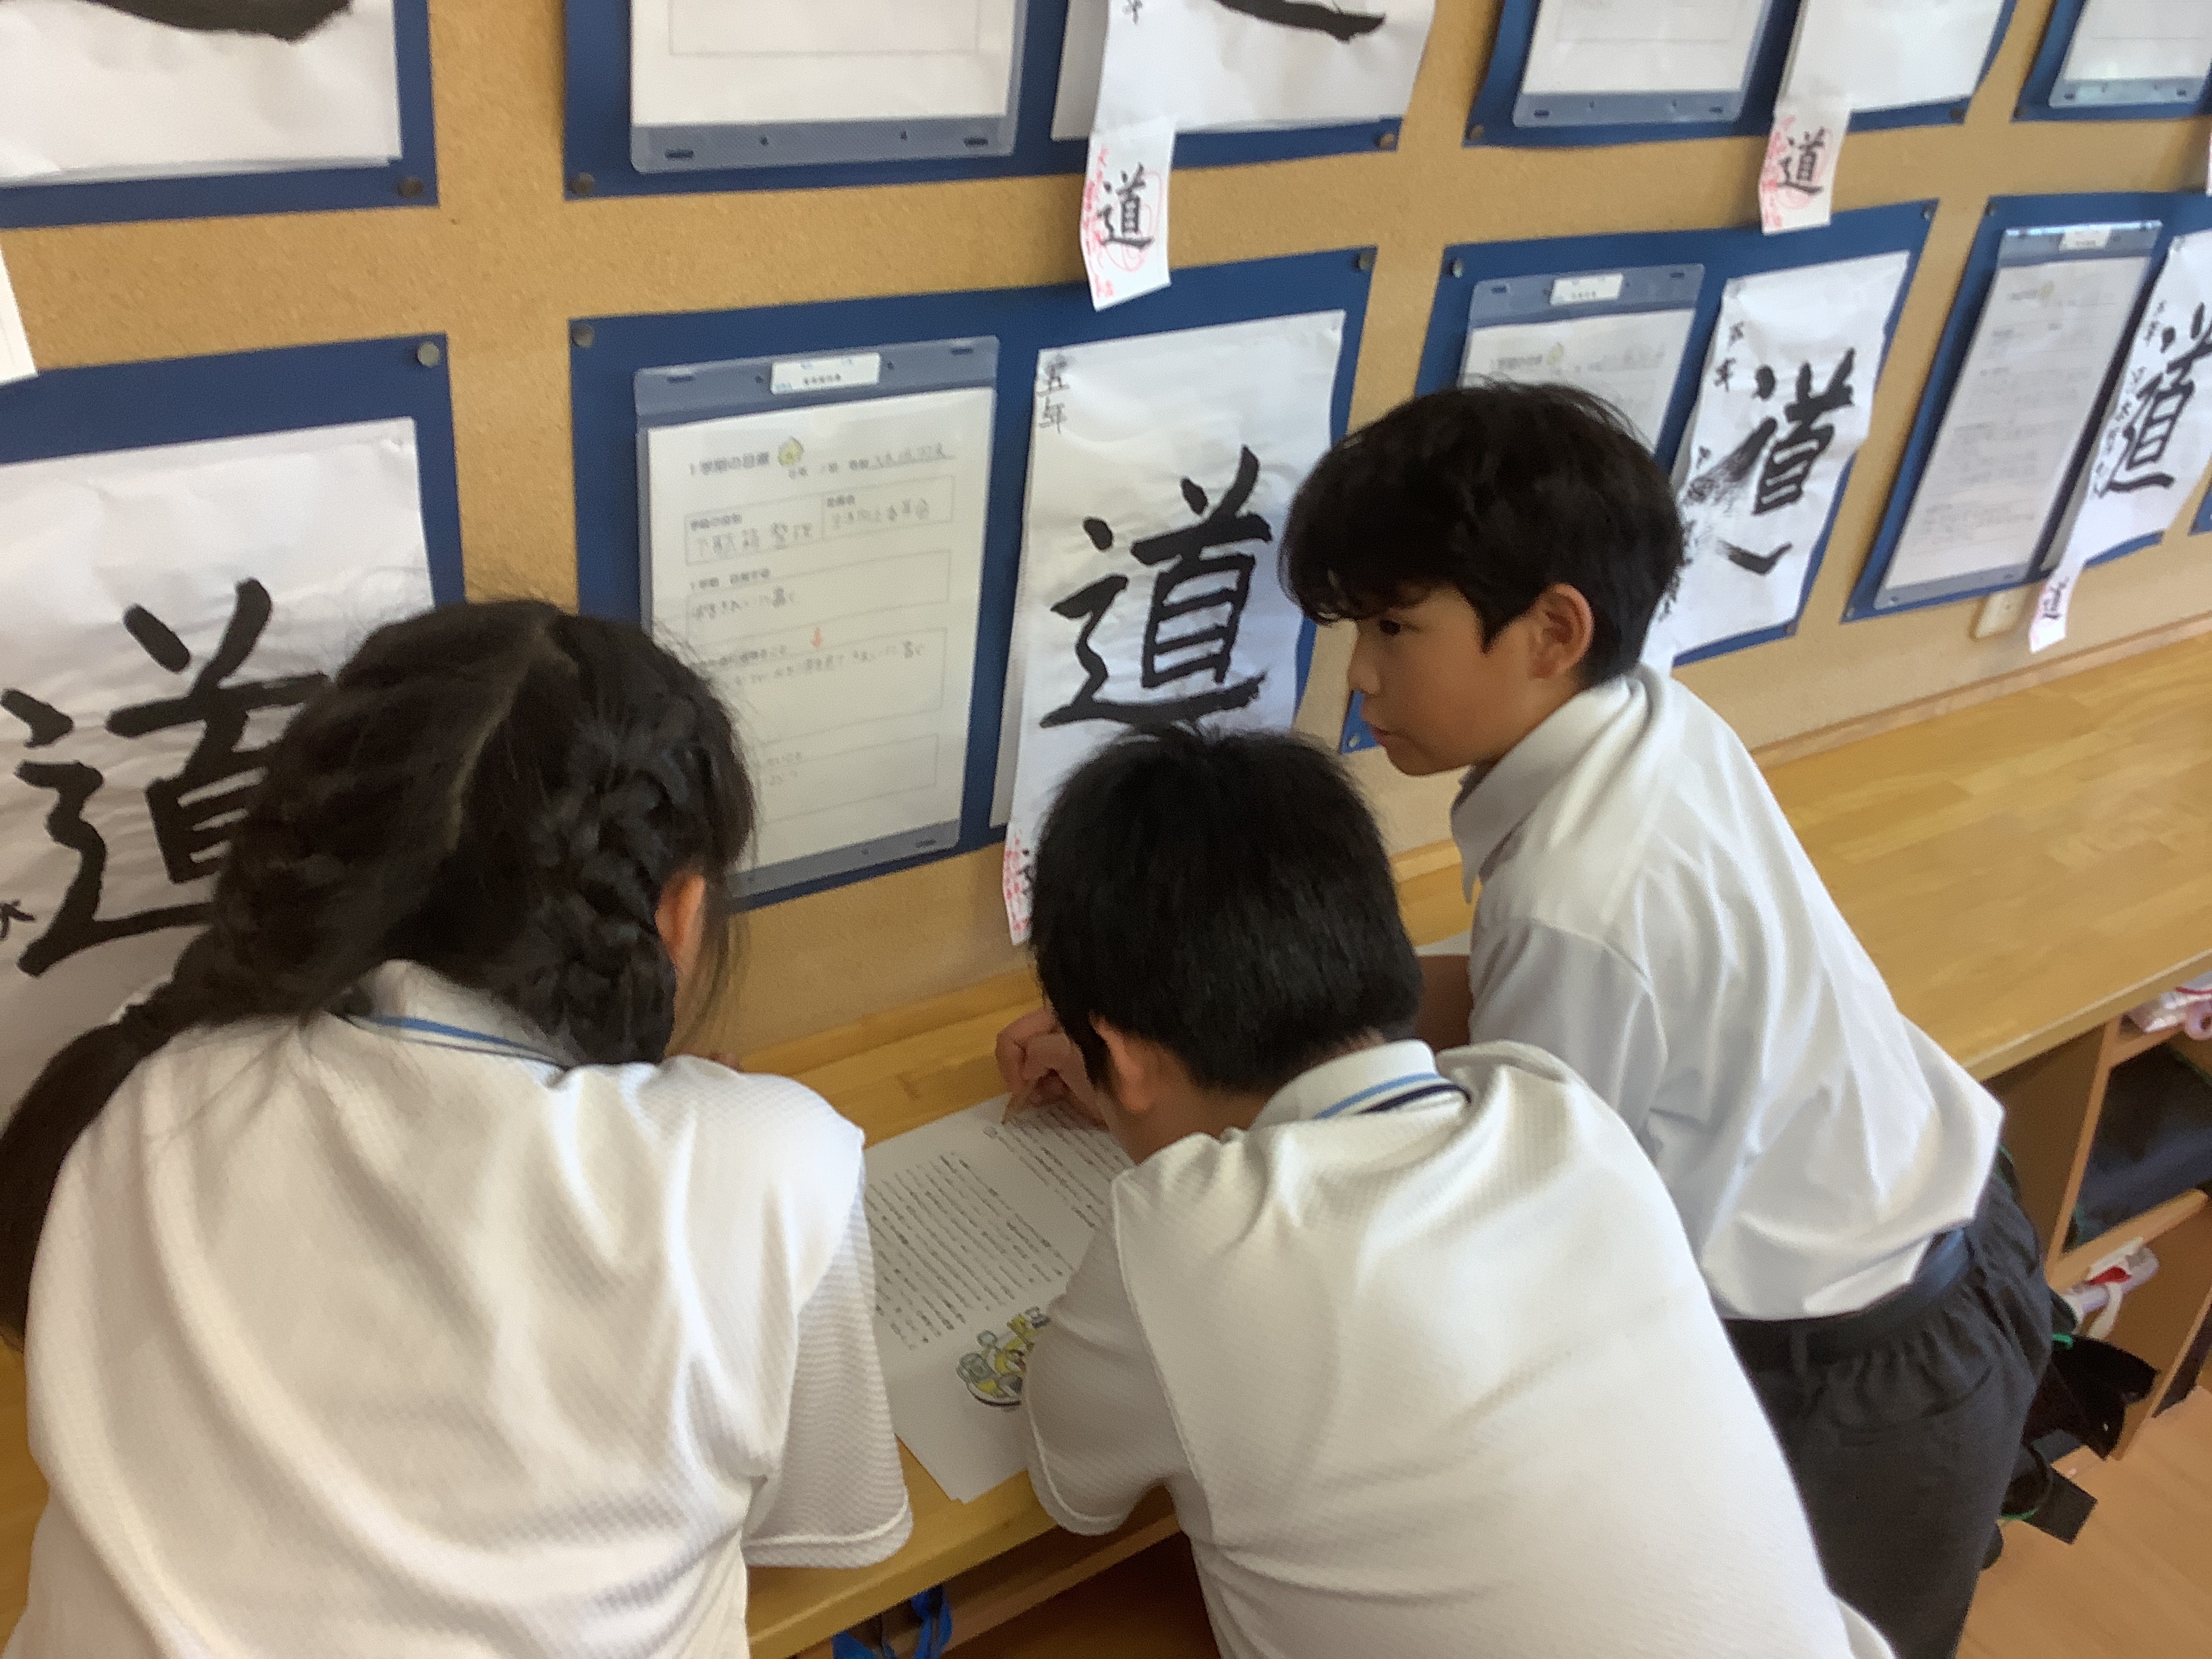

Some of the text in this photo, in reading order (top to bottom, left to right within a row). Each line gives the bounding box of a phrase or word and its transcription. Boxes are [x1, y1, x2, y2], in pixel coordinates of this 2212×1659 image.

[1097, 161, 1155, 250] 道
[1778, 126, 1825, 196] 道
[1035, 353, 1072, 434] 五年
[2096, 301, 2212, 499] 道
[1039, 444, 1273, 732] 道
[0, 576, 339, 977] 道
